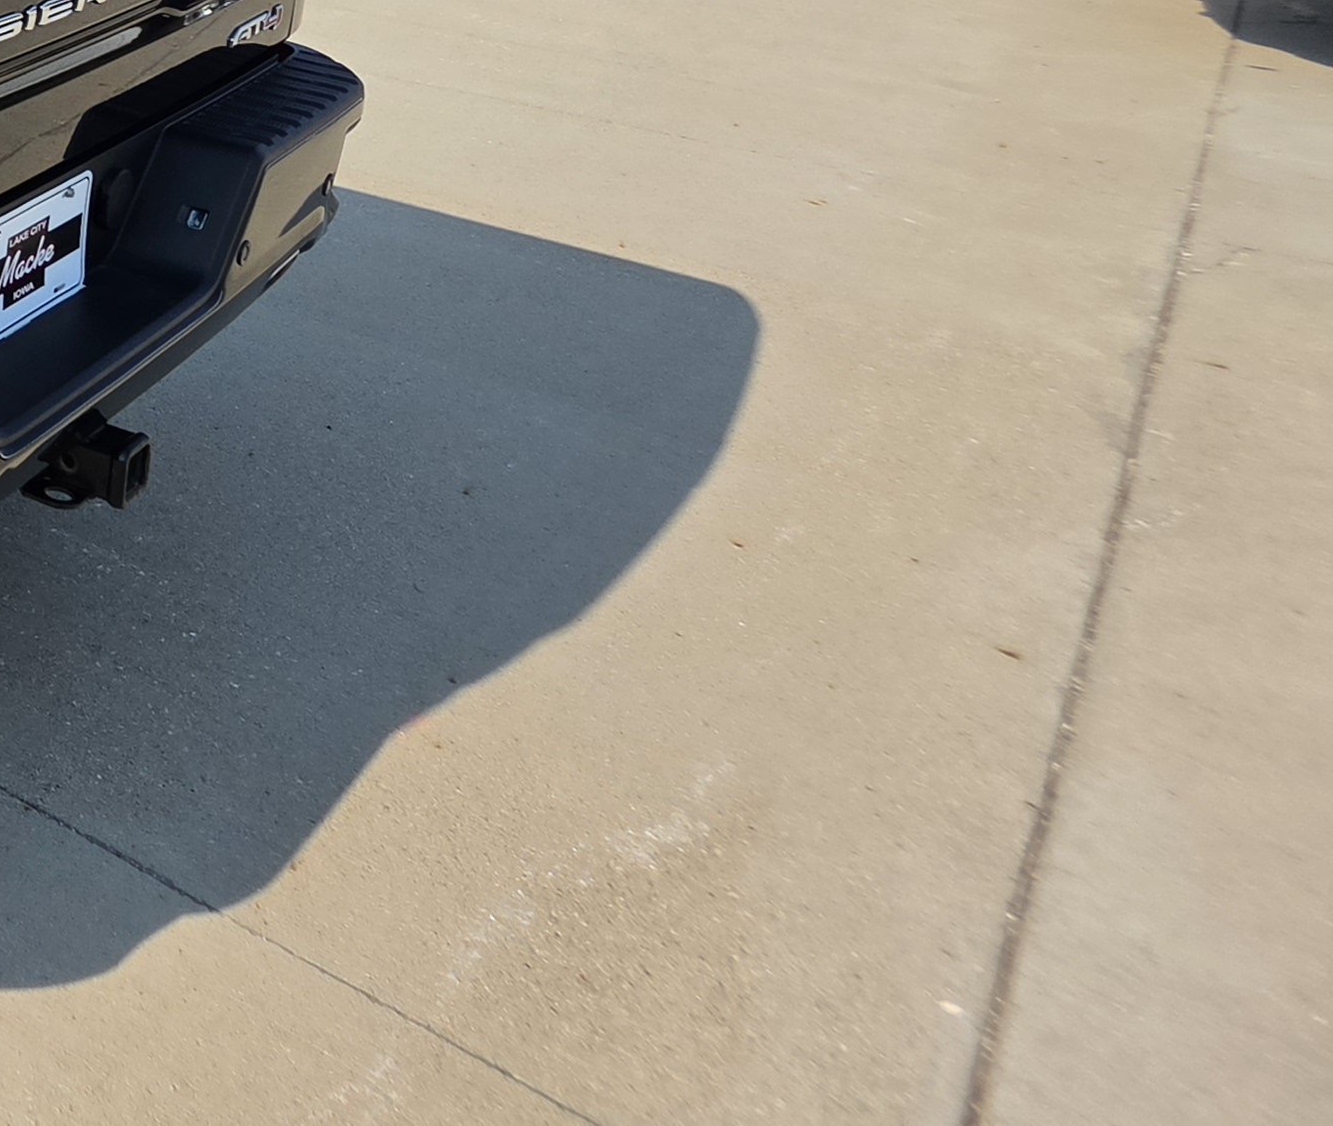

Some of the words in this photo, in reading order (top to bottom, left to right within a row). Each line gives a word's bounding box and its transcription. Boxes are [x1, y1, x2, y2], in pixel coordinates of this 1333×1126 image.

[227, 2, 285, 48] AT4
[9, 230, 30, 249] LAKE
[30, 220, 49, 237] CITY
[13, 282, 35, 301] IOWA
